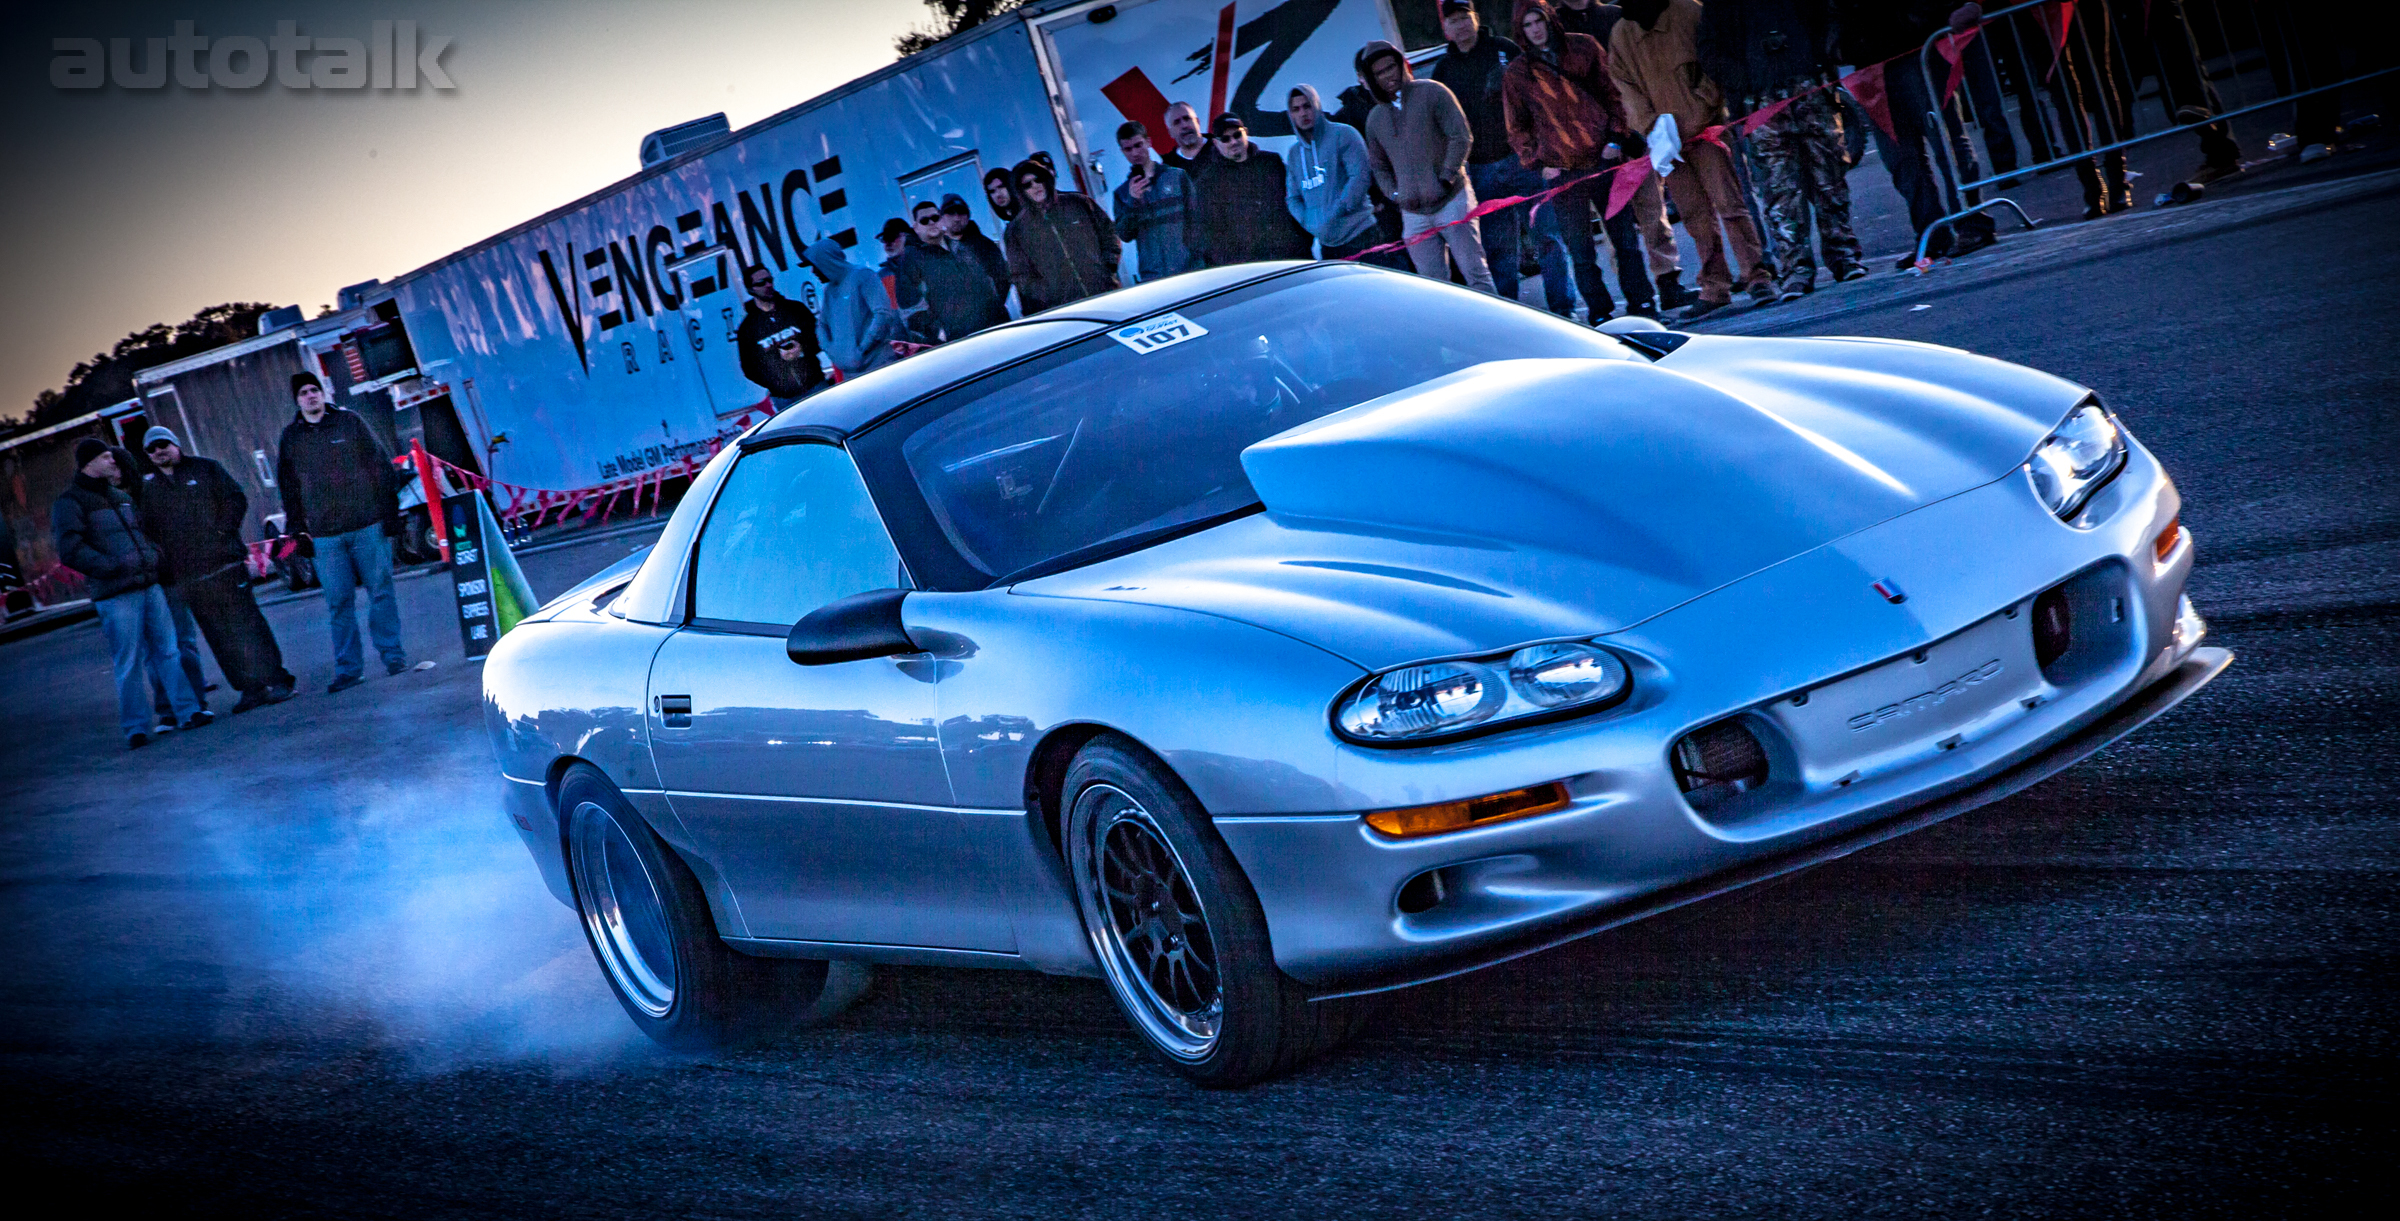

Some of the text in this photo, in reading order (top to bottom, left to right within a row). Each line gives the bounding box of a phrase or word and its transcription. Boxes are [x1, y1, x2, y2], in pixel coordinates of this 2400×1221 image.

[537, 155, 858, 380] VENGEANCE
[621, 281, 821, 374] RACIG
[1133, 323, 1190, 349] 107
[615, 449, 645, 474] Model
[1847, 657, 2004, 734] CAMARO
